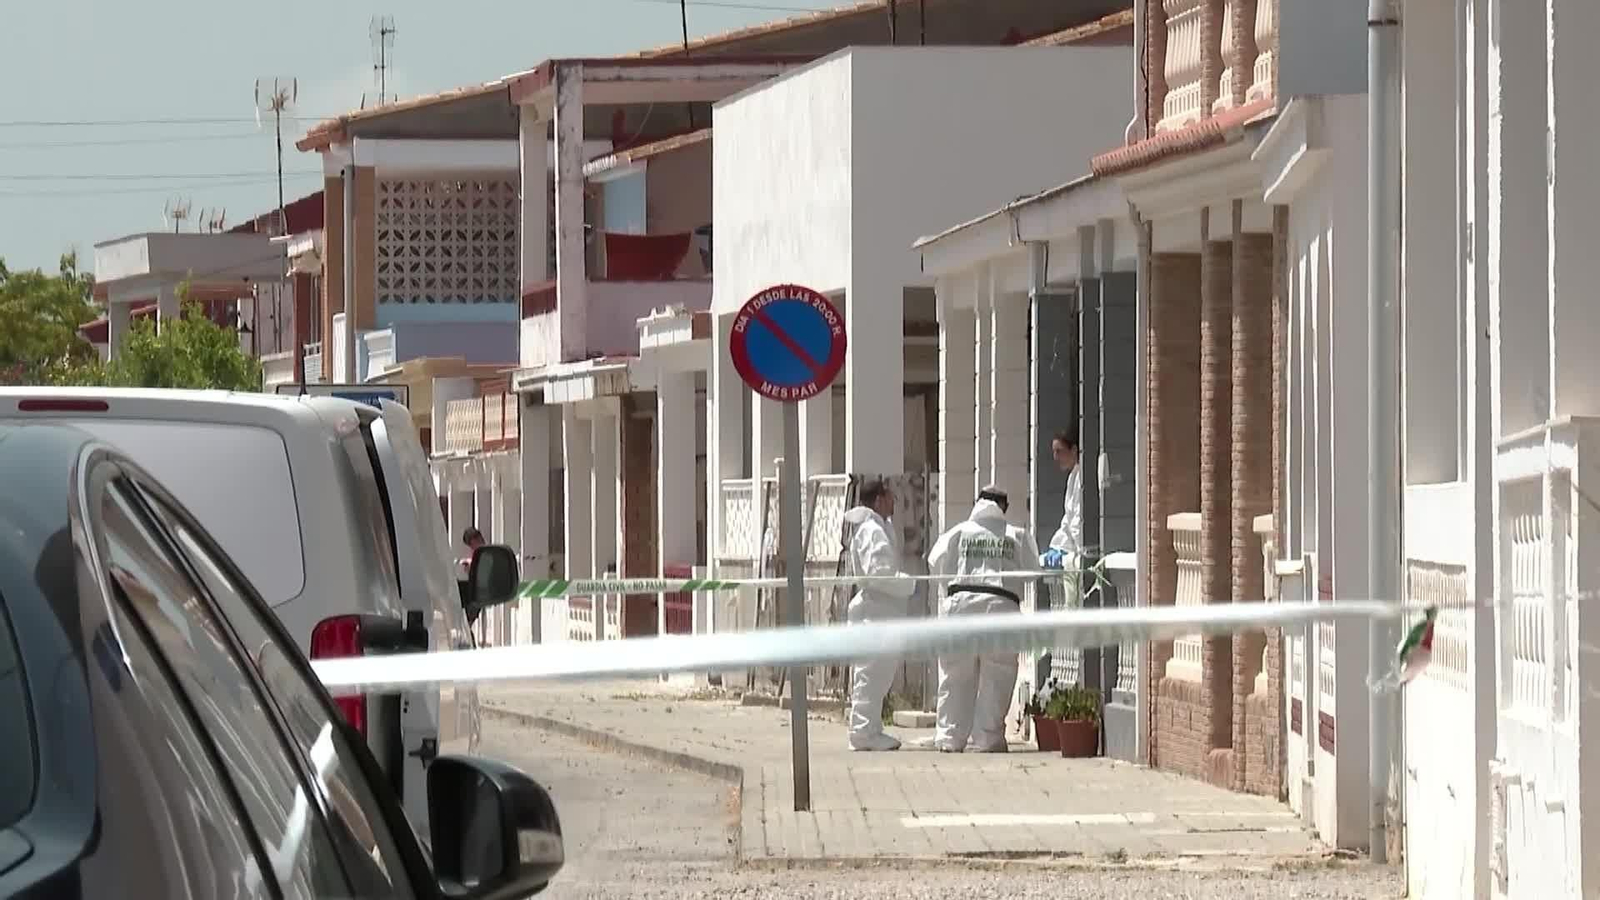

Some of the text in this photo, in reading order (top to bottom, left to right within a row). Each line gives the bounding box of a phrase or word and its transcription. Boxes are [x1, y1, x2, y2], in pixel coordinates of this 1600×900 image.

[735, 315, 748, 333] DIA
[754, 289, 786, 309] DESDE
[790, 288, 810, 302] LAS
[760, 381, 818, 397] MES PAR
[961, 539, 996, 549] GUARDIA
[576, 581, 606, 593] GUARDIA
[608, 581, 626, 592] CIVIL
[633, 581, 645, 590] NO
[646, 580, 667, 589] PASAR
